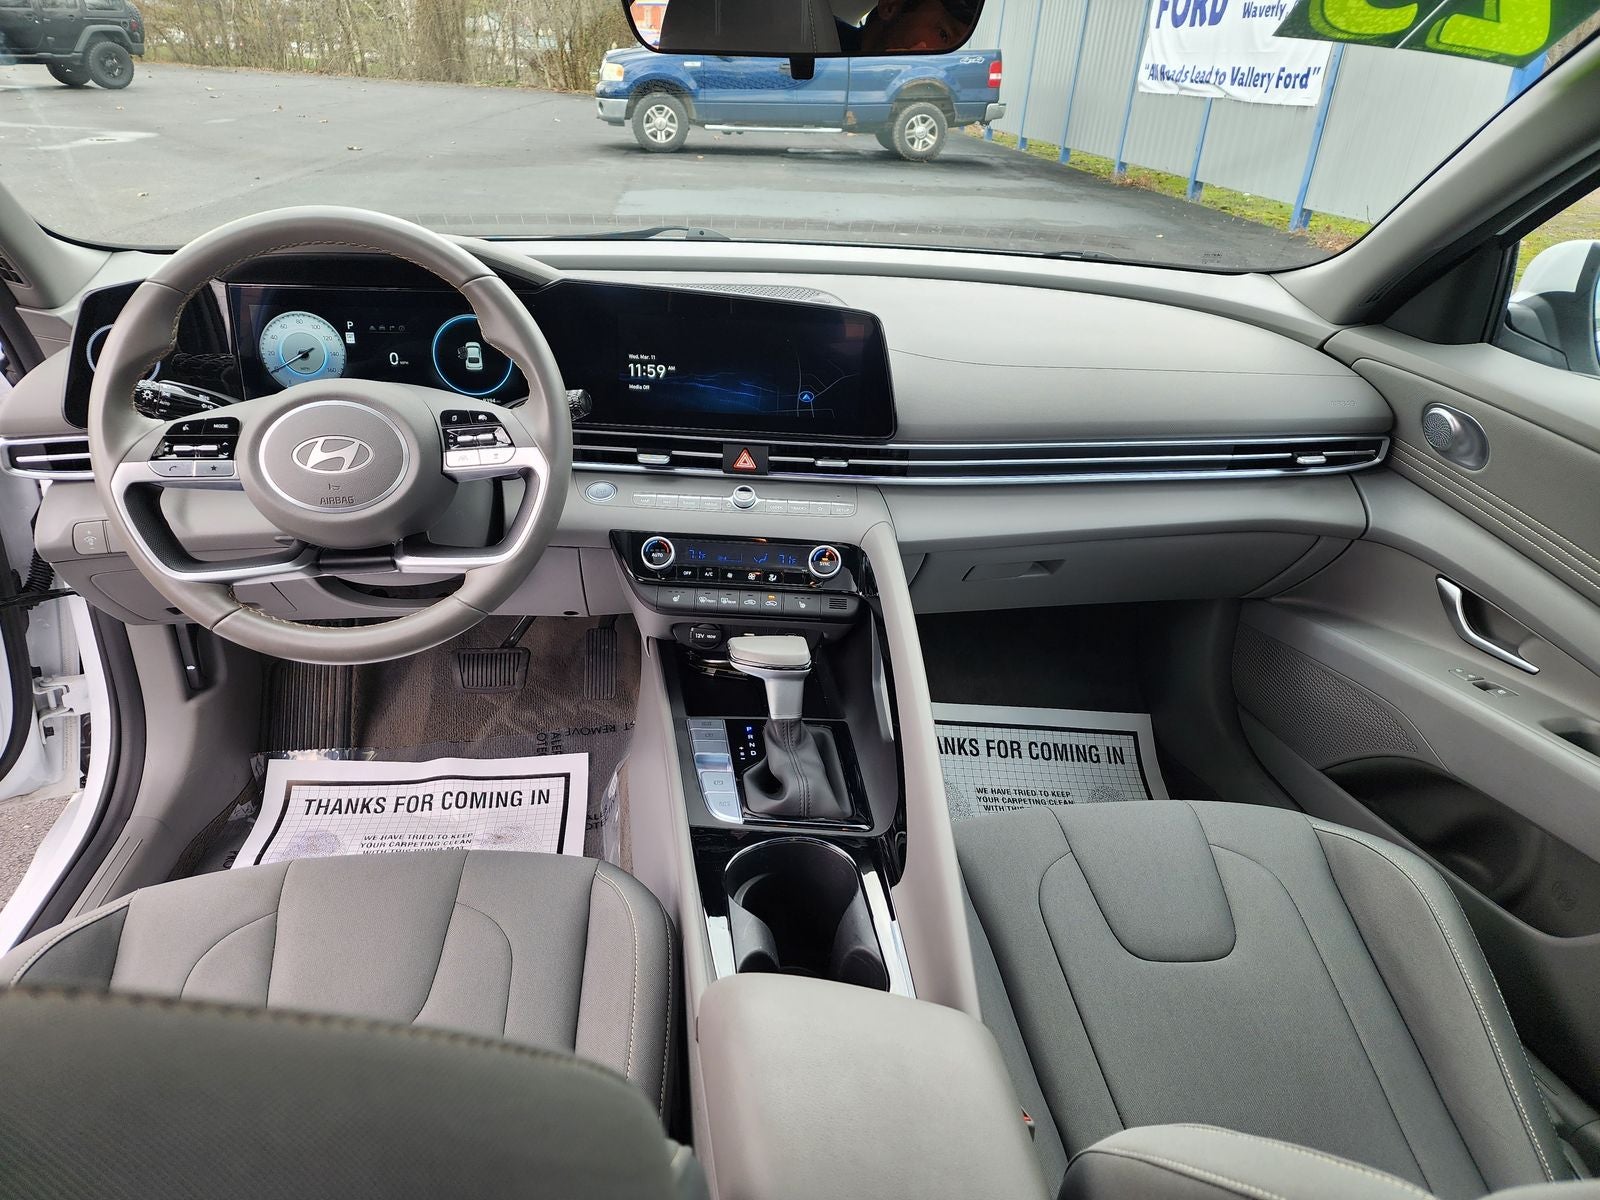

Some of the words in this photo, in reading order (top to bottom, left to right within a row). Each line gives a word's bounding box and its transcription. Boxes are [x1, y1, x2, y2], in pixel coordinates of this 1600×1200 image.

[1190, 65, 1211, 83] Lead
[1213, 66, 1226, 85] to
[1230, 66, 1275, 93] Vallery
[346, 321, 354, 330] P
[389, 352, 399, 365] 0
[628, 363, 666, 378] 11:59
[320, 495, 355, 505] AIRBAG
[985, 739, 1022, 759] FOR
[1028, 741, 1101, 763] COMING
[1106, 746, 1125, 765] IN
[304, 796, 387, 816] THANKS
[393, 793, 434, 813] FOR
[441, 790, 523, 810] COMING
[530, 789, 550, 805] IN
[976, 795, 1000, 803] YOUR
[1001, 797, 1047, 806] CARPETING
